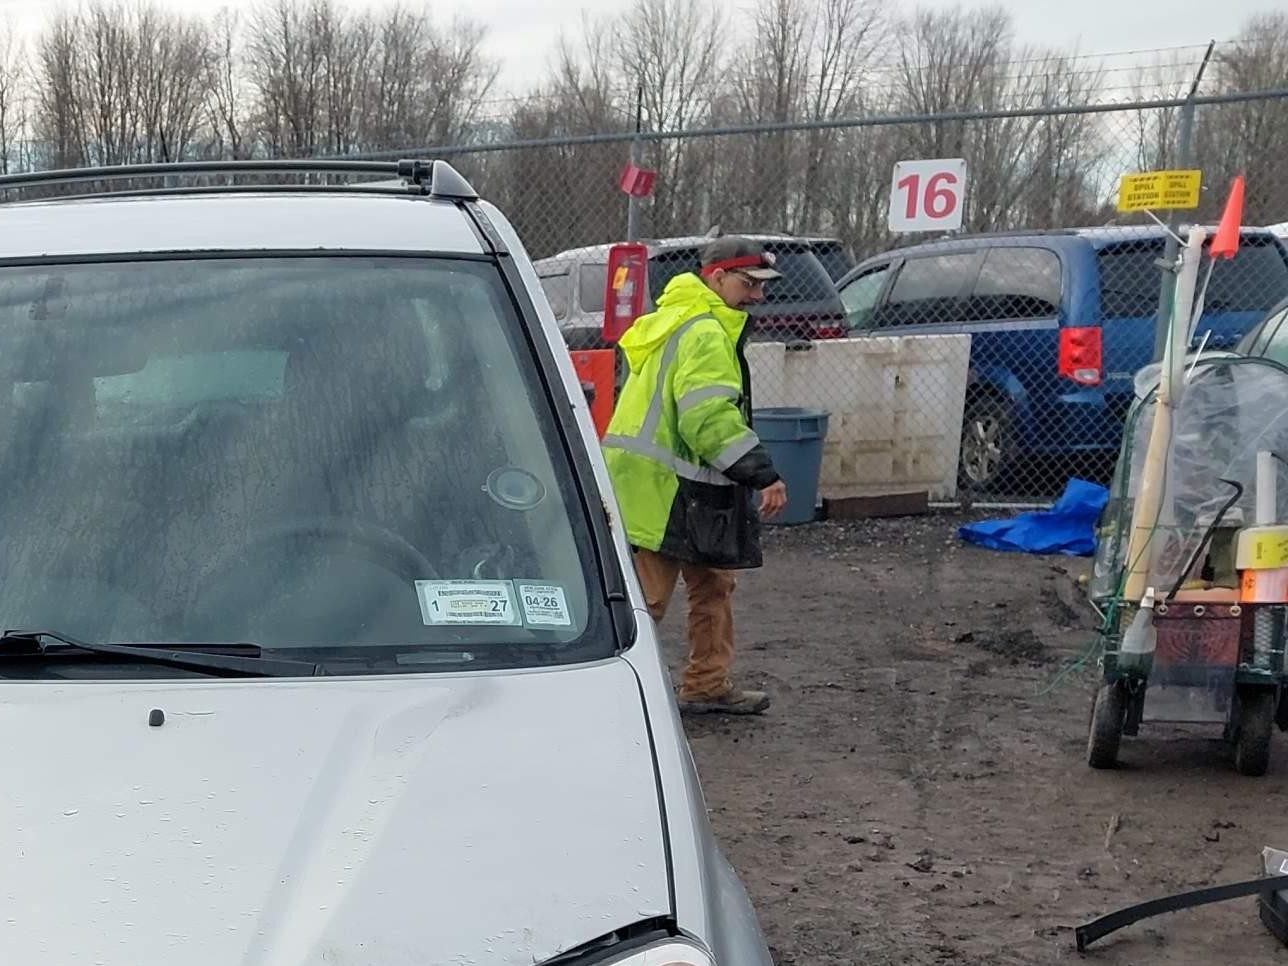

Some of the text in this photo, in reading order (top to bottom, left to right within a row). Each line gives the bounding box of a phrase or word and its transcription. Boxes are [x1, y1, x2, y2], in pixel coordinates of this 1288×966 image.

[898, 172, 958, 219] 16
[490, 600, 508, 612] 27
[525, 595, 558, 607] 04-26
